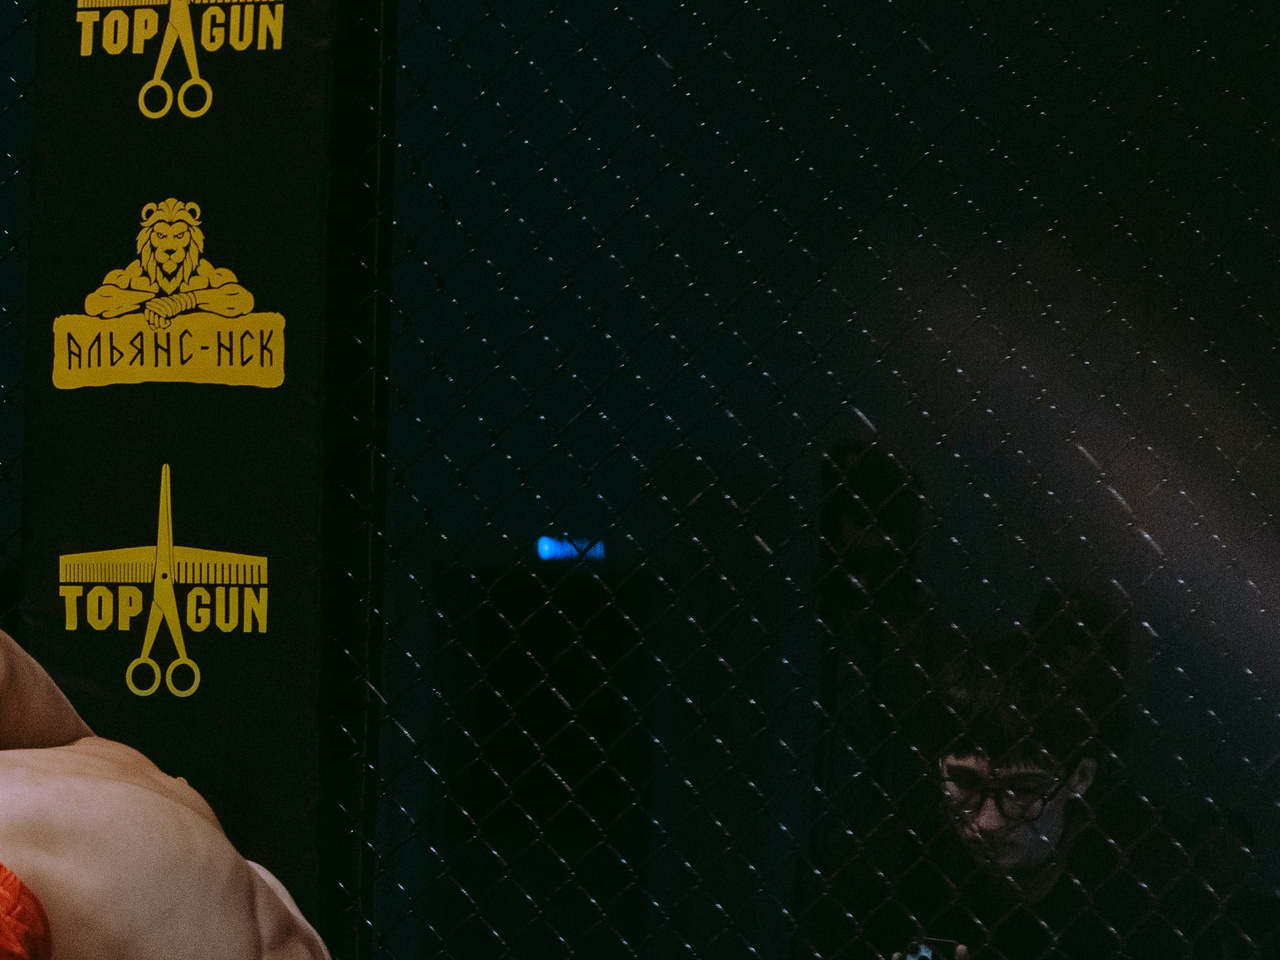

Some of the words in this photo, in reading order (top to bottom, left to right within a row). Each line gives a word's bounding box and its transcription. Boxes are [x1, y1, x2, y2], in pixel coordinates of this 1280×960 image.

[77, 9, 159, 56] TOP
[201, 4, 284, 51] GUN
[67, 328, 274, 370] АЛЬЯНС-НСК
[59, 586, 143, 631] TOP
[186, 586, 268, 633] GUN
